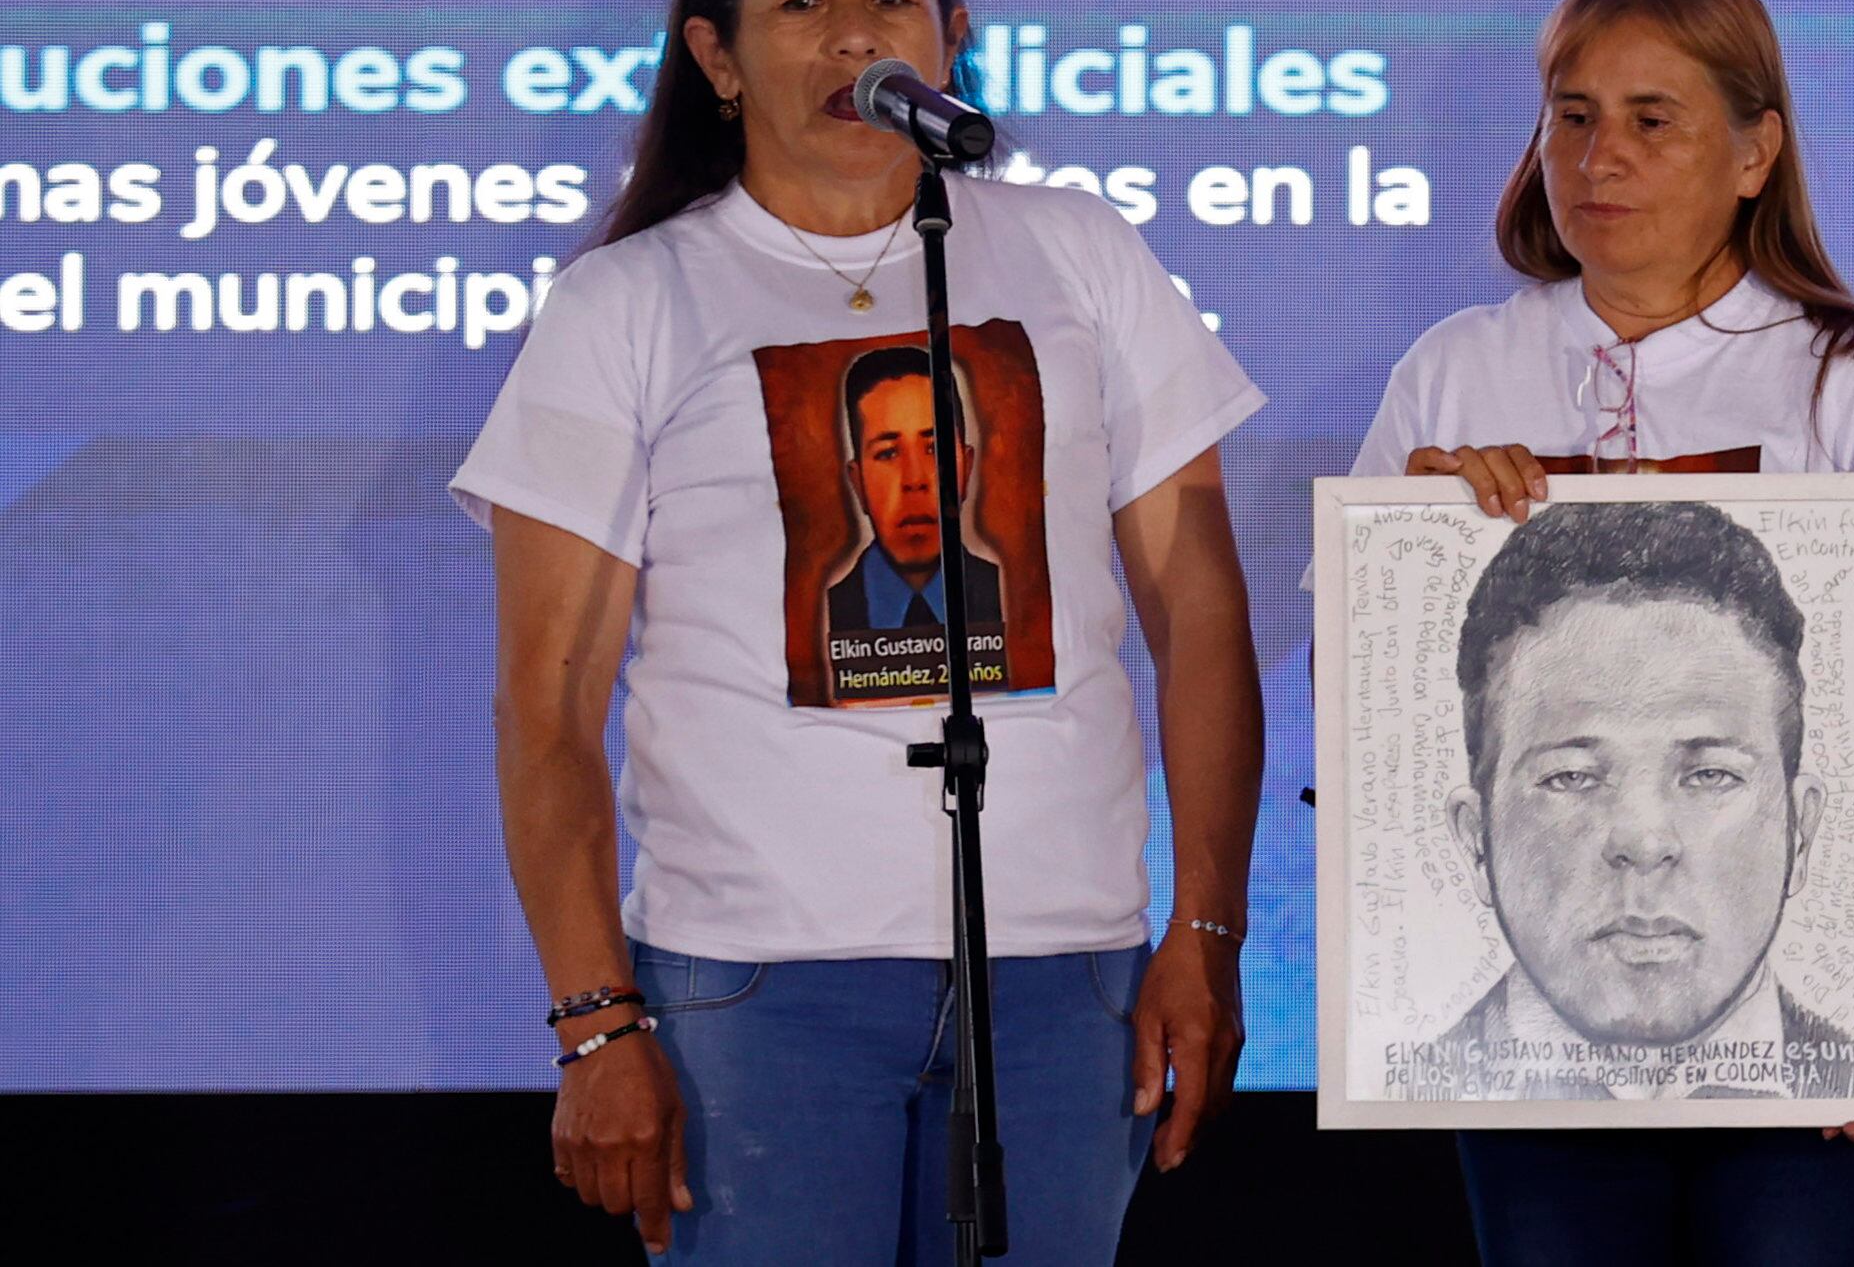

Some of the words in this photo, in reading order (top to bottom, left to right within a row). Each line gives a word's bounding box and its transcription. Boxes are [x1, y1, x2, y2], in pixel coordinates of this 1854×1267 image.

[0, 21, 469, 114] uciones
[180, 138, 589, 240] jóvenes
[1186, 164, 1333, 226] en
[1347, 146, 1433, 226] la
[0, 251, 85, 332] el
[1758, 509, 1828, 535] Elkin
[830, 636, 872, 661] Elkin
[874, 636, 945, 657] Gustavo
[966, 634, 1004, 652] rano
[838, 663, 936, 689] Hernández,
[937, 664, 949, 684] 2
[1352, 750, 1378, 831] Verano
[1463, 1037, 1554, 1066] GUSTAVO
[1561, 1040, 1648, 1065] VERANO
[1596, 1063, 1678, 1088] POSITIVOS
[1685, 1063, 1708, 1084] EN
[1714, 1062, 1822, 1085] COLOMBIA
